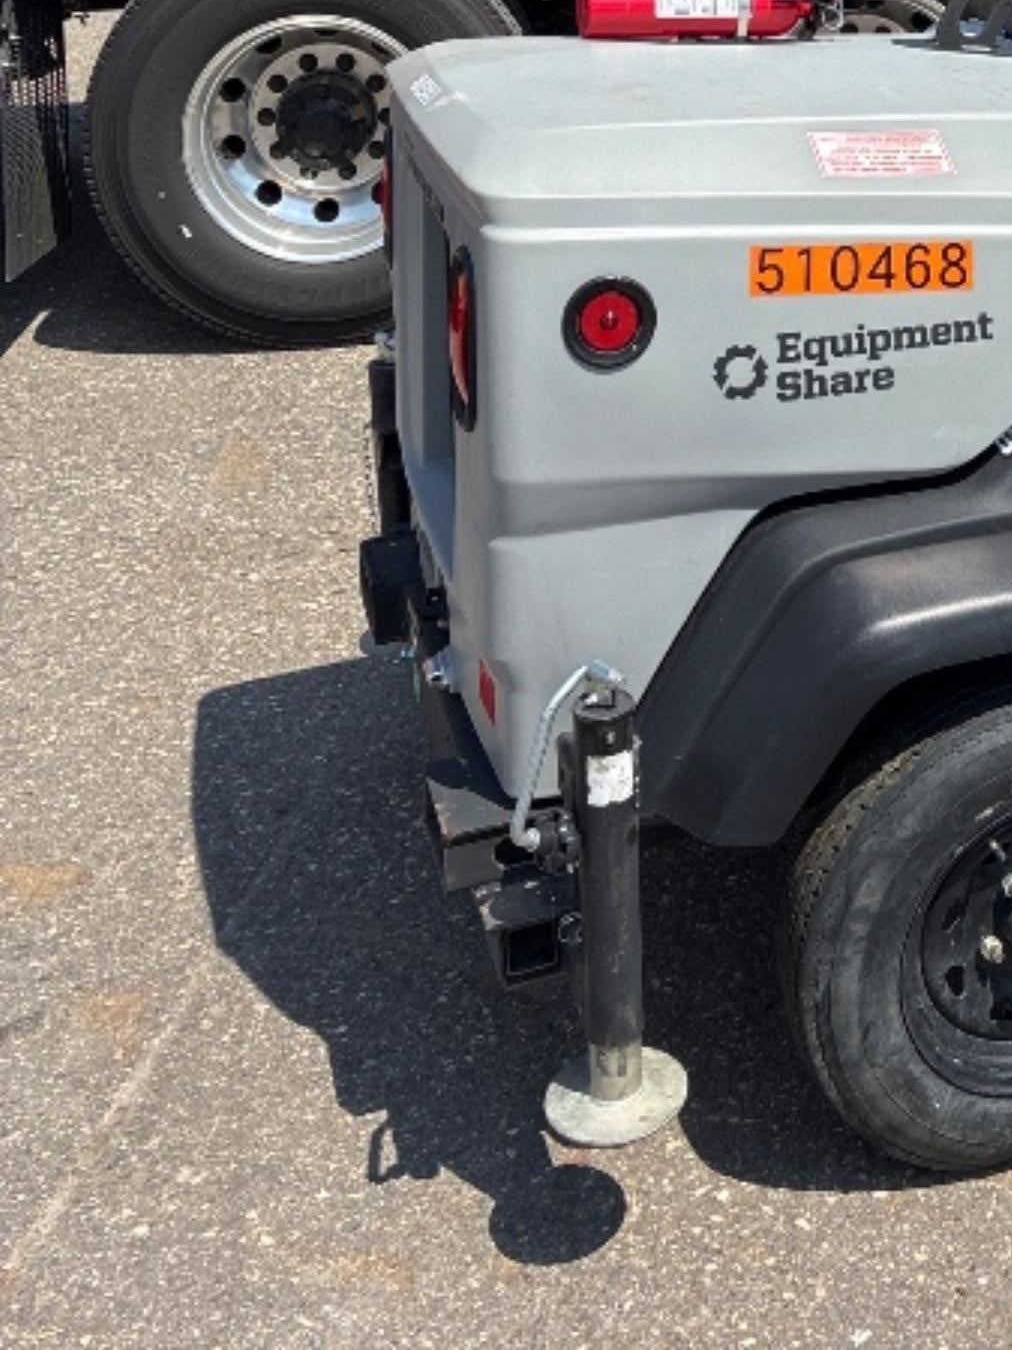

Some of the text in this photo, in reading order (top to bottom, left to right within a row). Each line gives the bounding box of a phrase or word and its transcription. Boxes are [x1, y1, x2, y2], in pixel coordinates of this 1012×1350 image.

[756, 242, 968, 294] 510468
[776, 311, 993, 364] Equipment
[776, 365, 895, 402] Share
